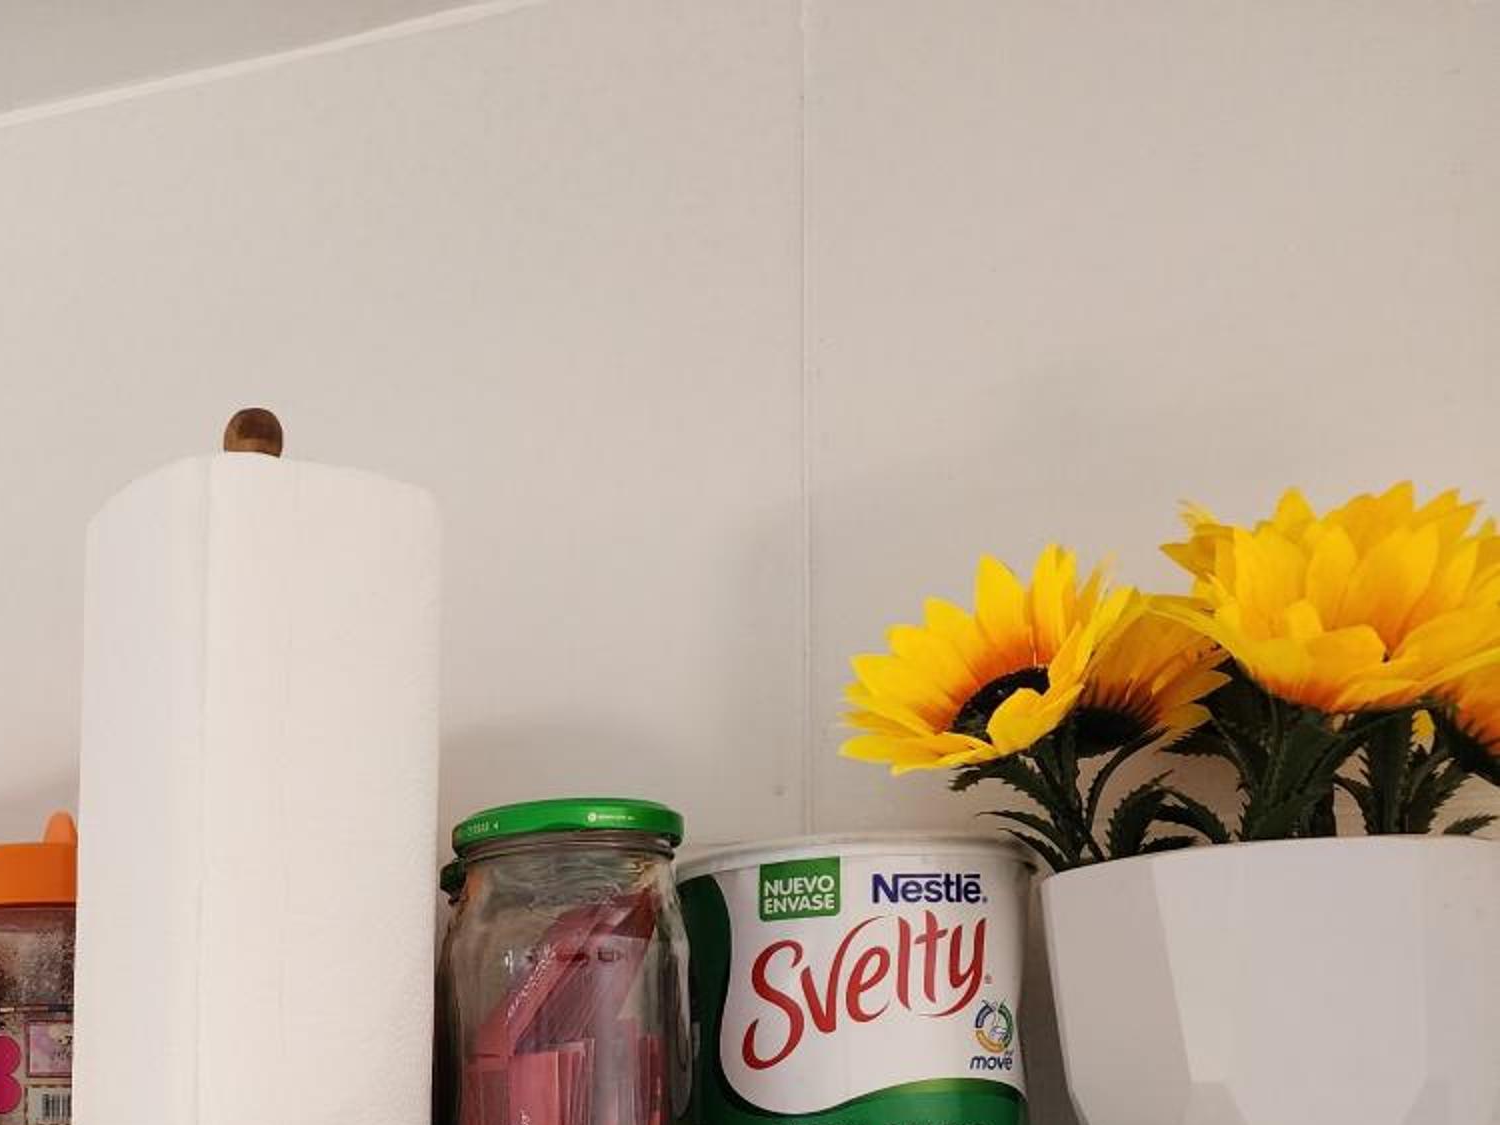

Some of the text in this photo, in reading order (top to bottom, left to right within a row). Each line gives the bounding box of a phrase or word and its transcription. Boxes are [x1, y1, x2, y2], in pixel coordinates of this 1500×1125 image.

[764, 875, 835, 897] NUEVO
[764, 893, 835, 914] ENVASE
[742, 909, 987, 1070] Svelty
[970, 1055, 1013, 1071] move
